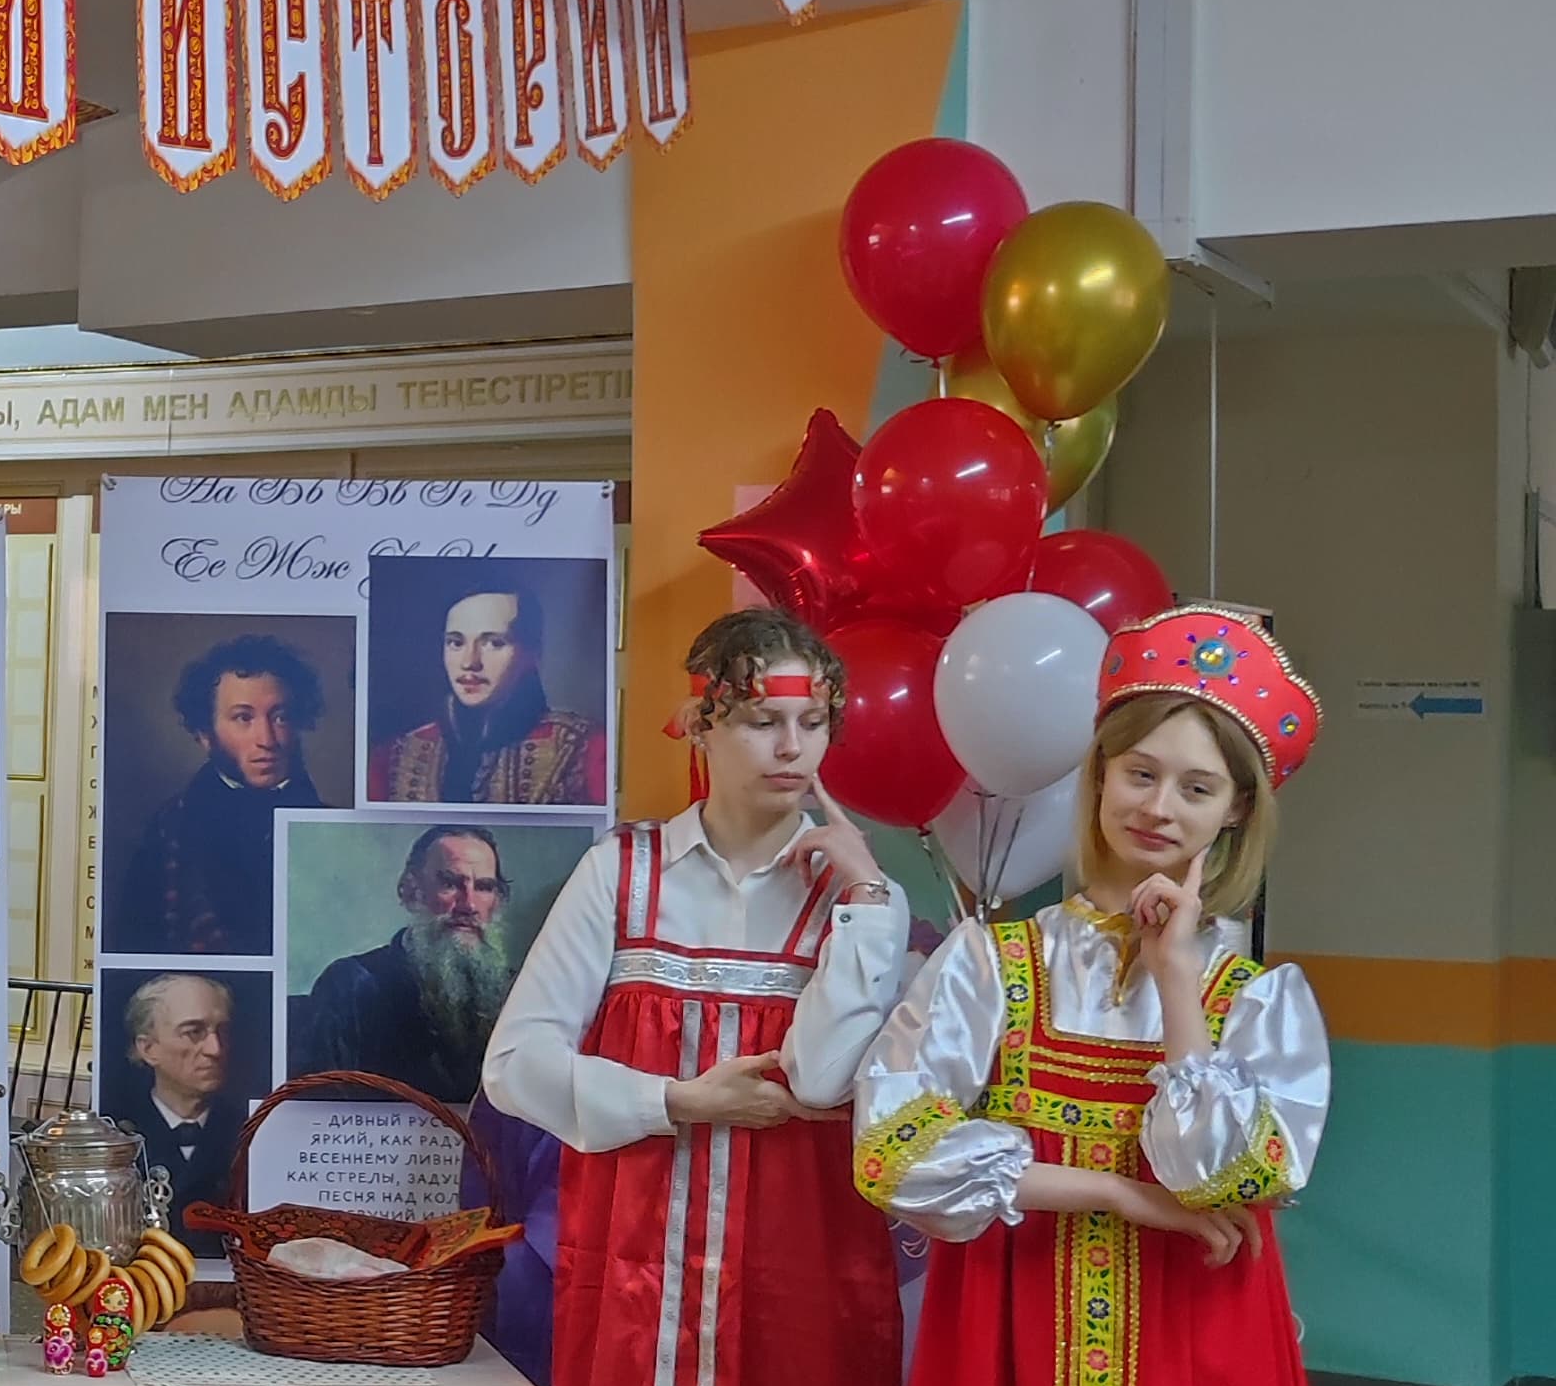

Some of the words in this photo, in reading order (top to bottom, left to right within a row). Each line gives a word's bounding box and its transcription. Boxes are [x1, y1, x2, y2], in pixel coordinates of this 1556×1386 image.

[37, 396, 125, 429] АДАМ
[144, 392, 209, 422] МЕН
[227, 382, 377, 422] АДАМДЫ
[161, 538, 226, 582] Ее
[328, 1113, 401, 1128] ДИВНЫЙ
[310, 1131, 374, 1148] ЯРКИЙ,
[380, 1135, 413, 1146] КАК
[299, 1151, 399, 1165] ВЕСЕННЕМУ
[287, 1171, 319, 1182] КАК
[326, 1171, 401, 1187] СТРЕЛЫ,
[318, 1190, 376, 1203] ПЕСНЯ
[382, 1192, 417, 1204] НАД
